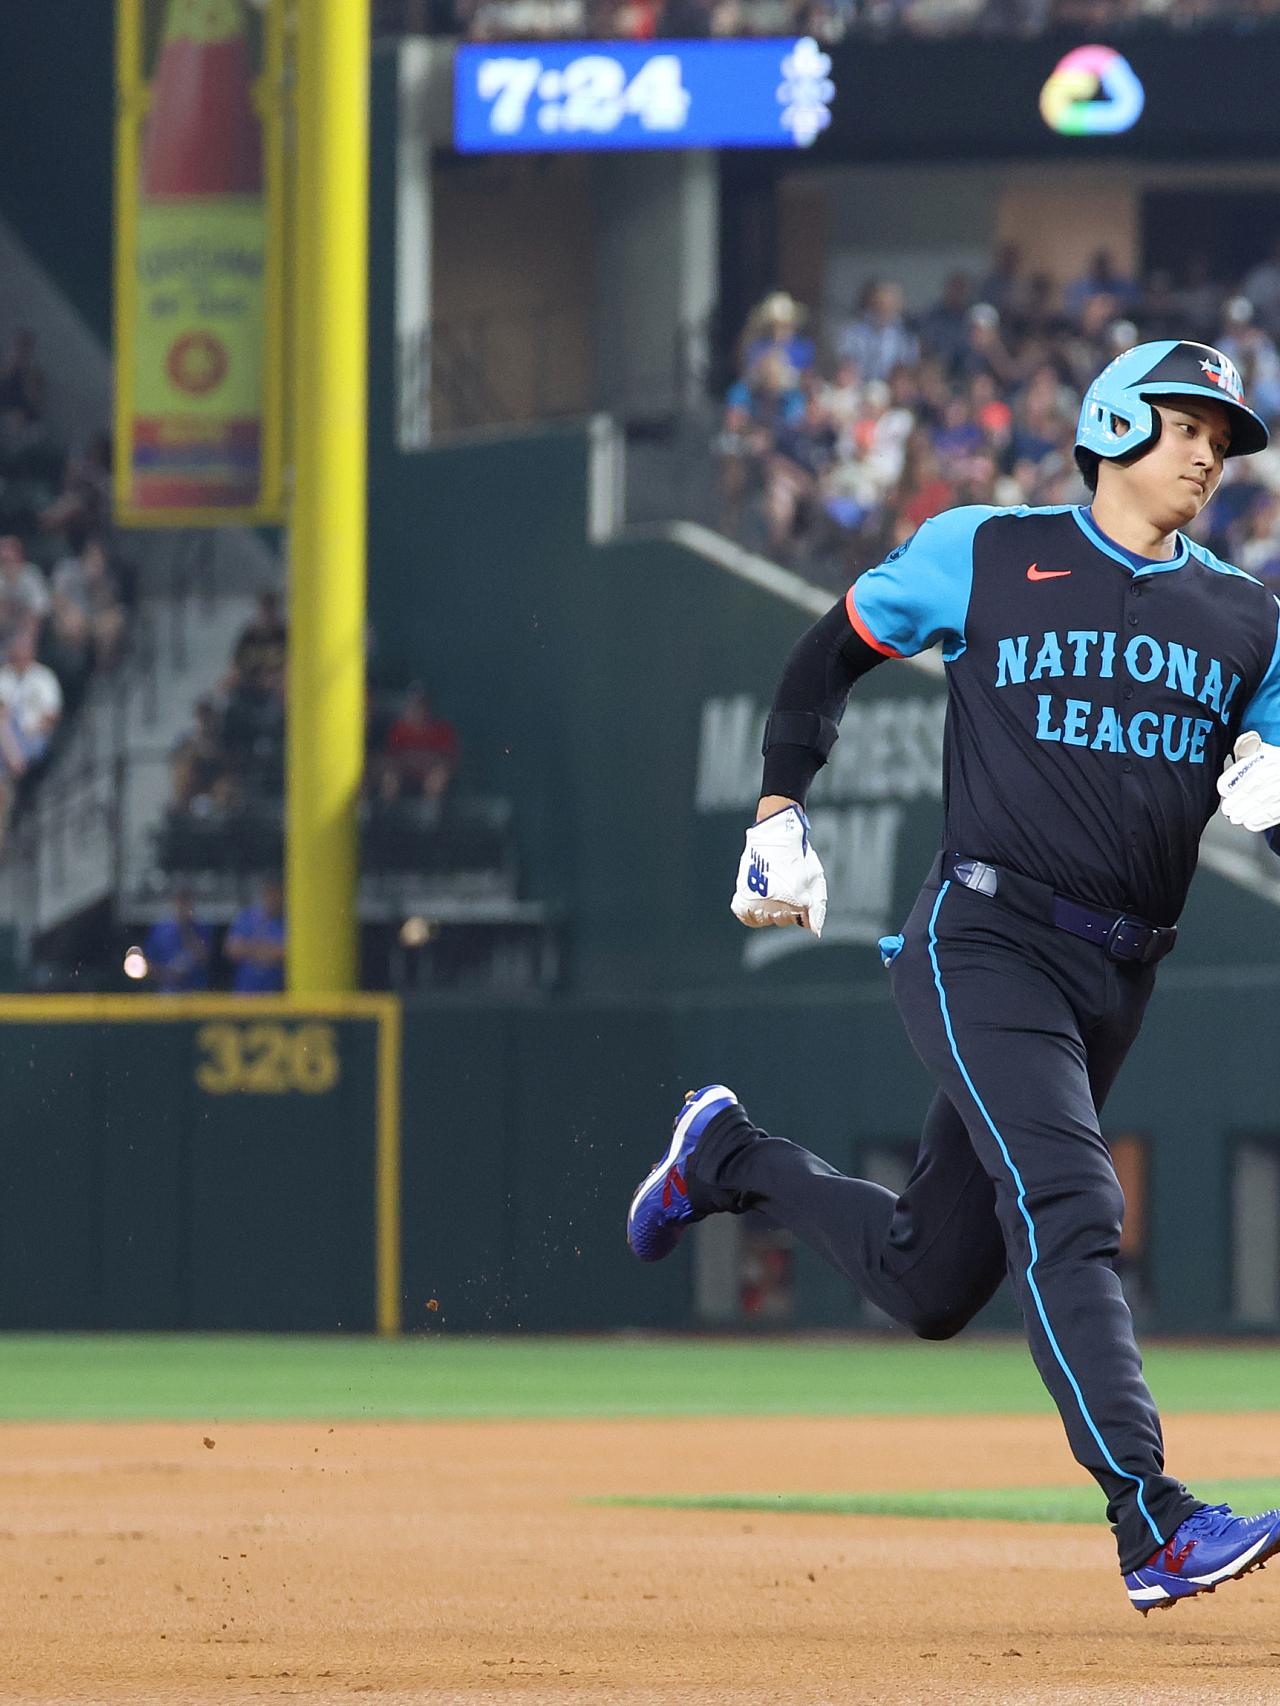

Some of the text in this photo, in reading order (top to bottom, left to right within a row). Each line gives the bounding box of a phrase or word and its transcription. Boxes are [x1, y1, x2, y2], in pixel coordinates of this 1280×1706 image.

[478, 54, 691, 135] 7:24
[994, 630, 1241, 726] NATIONAL
[1035, 694, 1213, 764] LEAGUE
[195, 1023, 340, 1094] 326
